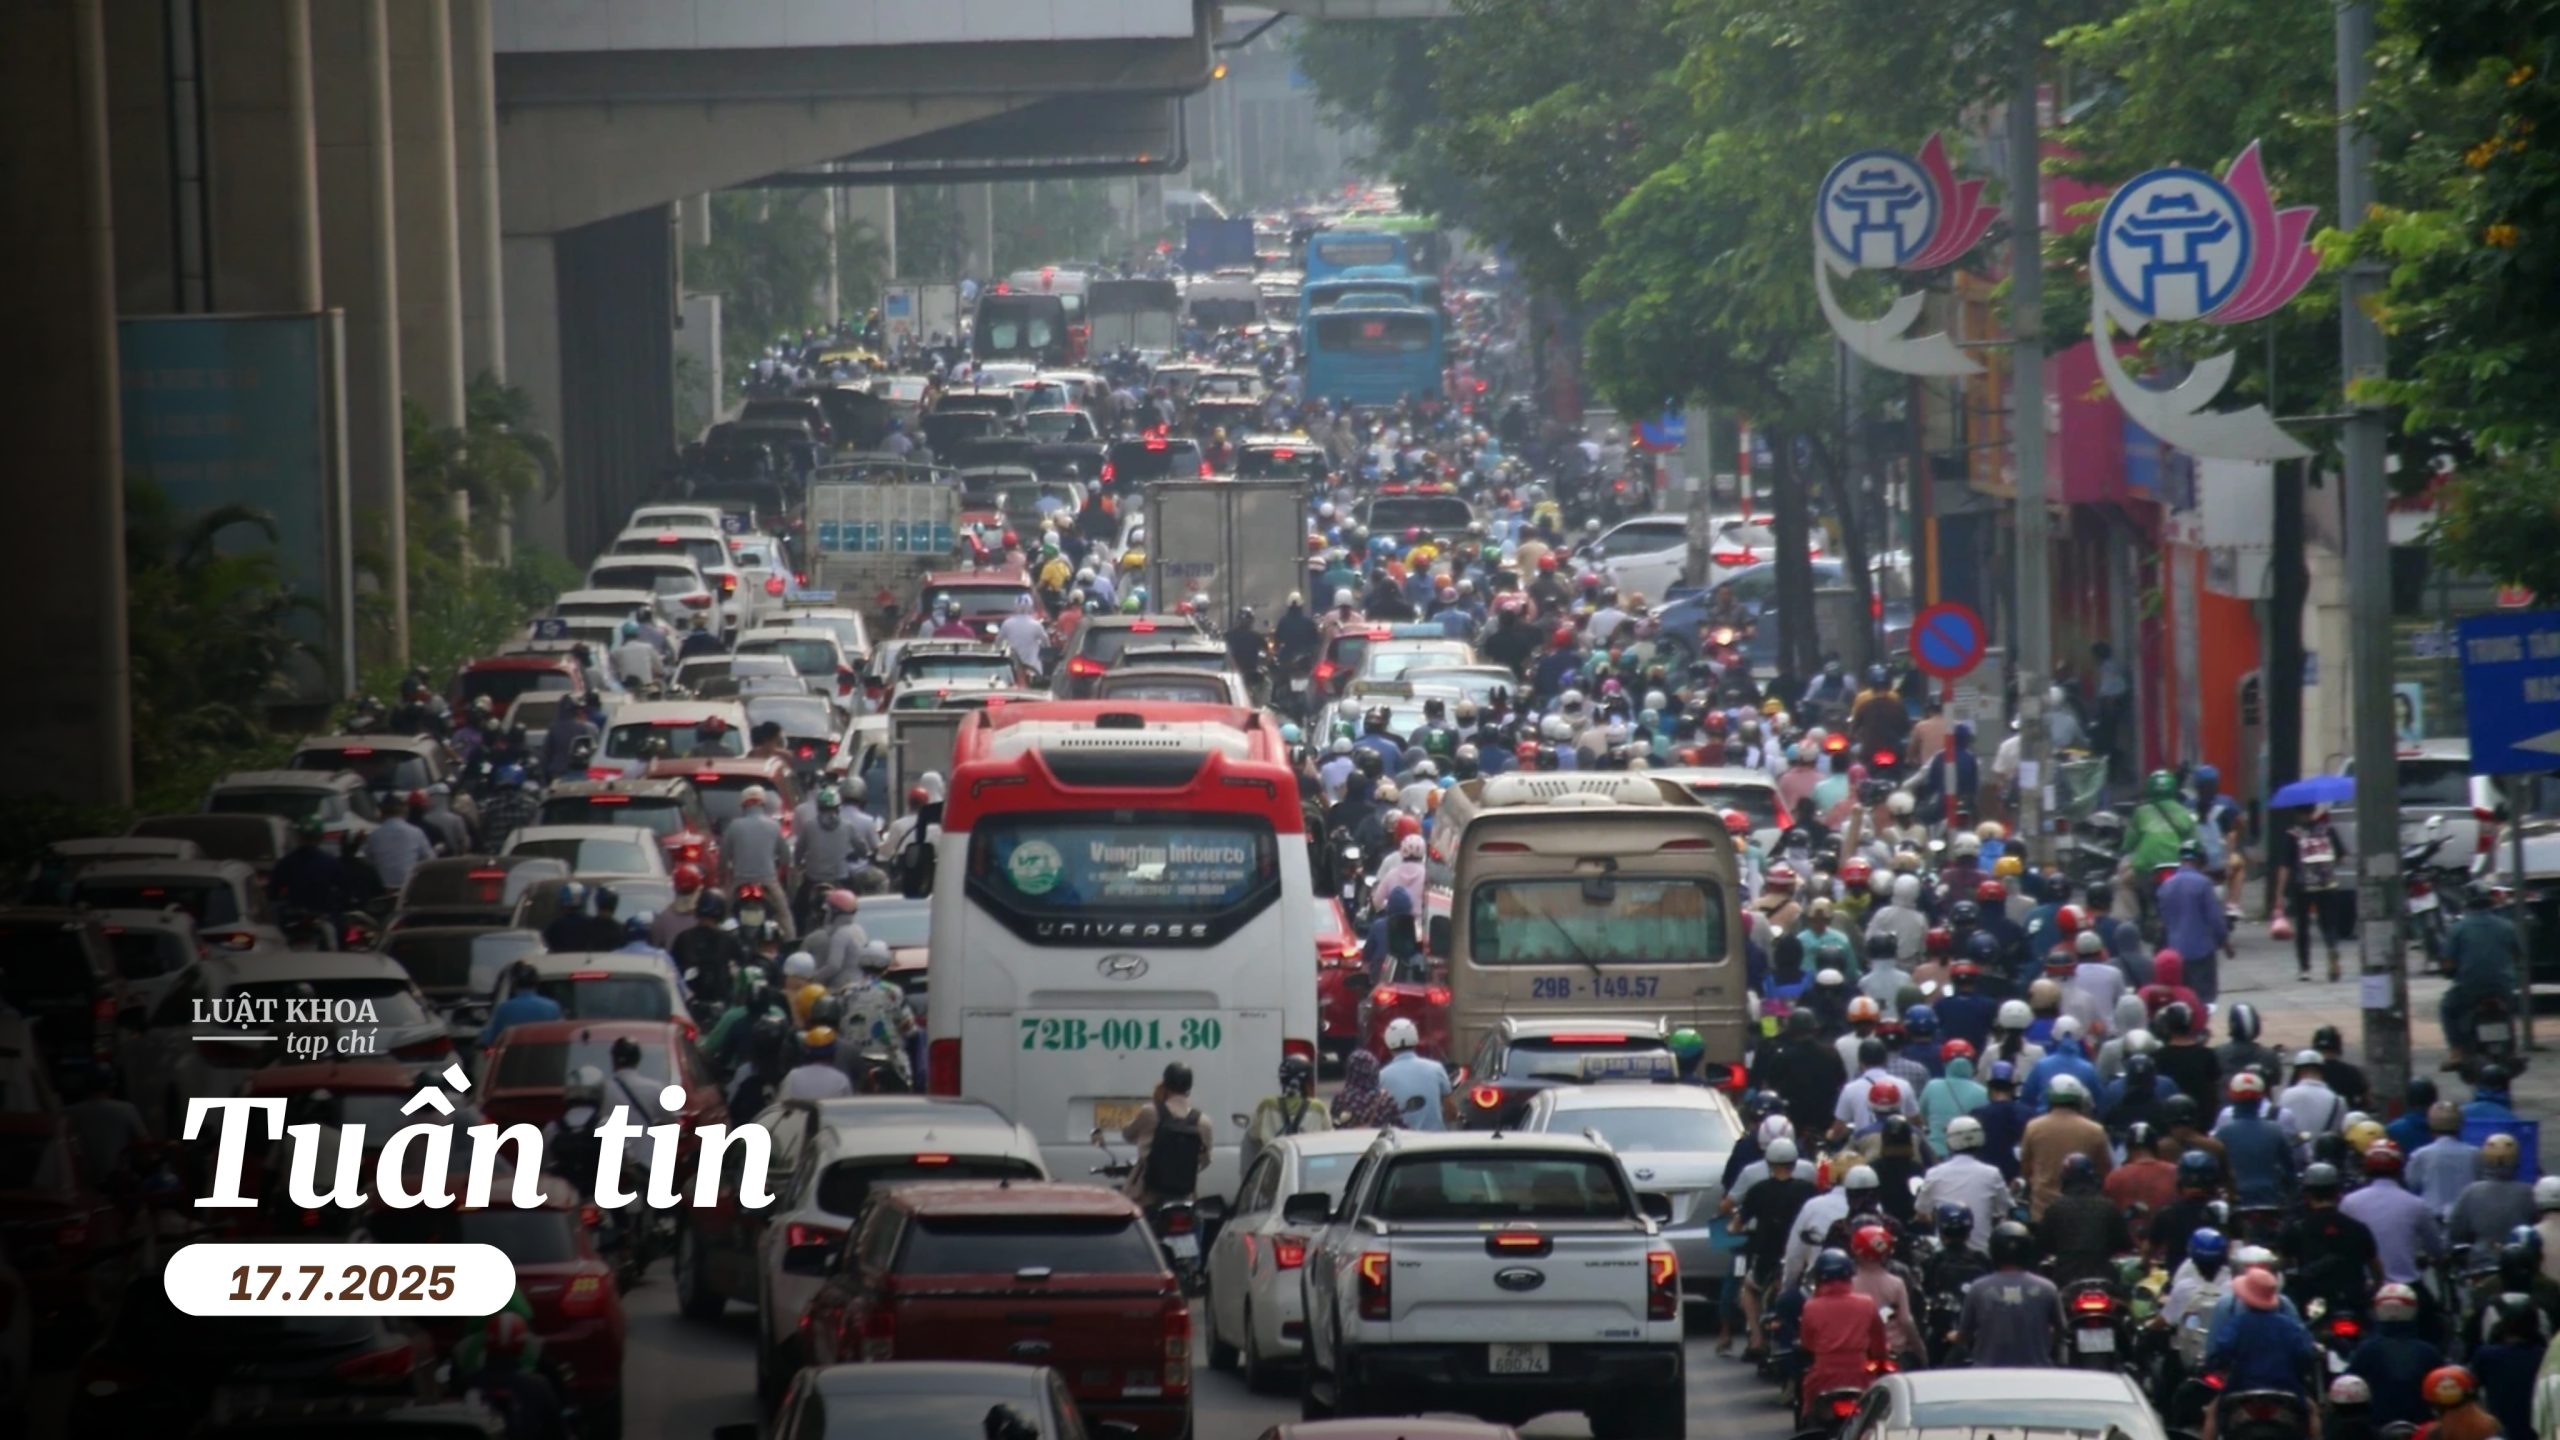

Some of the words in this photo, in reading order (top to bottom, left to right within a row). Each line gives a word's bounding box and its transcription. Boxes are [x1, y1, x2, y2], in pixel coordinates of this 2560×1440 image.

[1170, 843, 1245, 863] Intourco
[1037, 923, 1208, 937] UNIVERSE
[1532, 977, 1571, 998] 29B
[1592, 976, 1660, 998] 149.57
[1020, 1018, 1221, 1051] 72B-001.30
